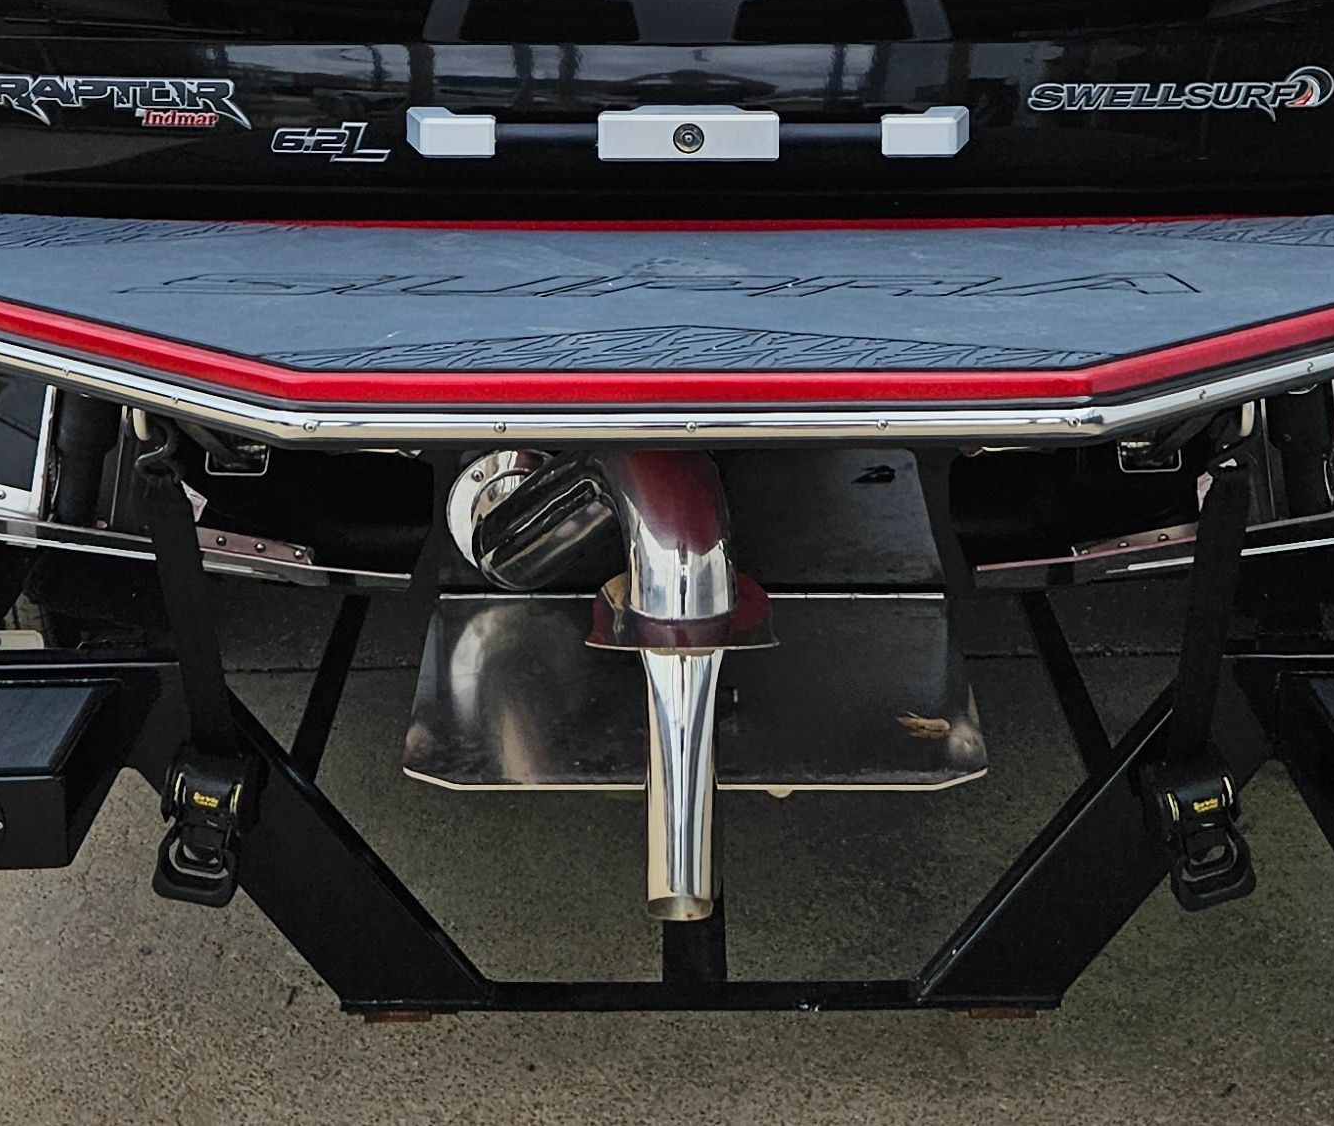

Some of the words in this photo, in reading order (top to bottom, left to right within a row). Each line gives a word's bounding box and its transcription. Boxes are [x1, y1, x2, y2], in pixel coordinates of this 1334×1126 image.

[142, 109, 219, 128] Indmar
[1027, 81, 1297, 121] SWELLSURF
[271, 122, 391, 162] 6.2L
